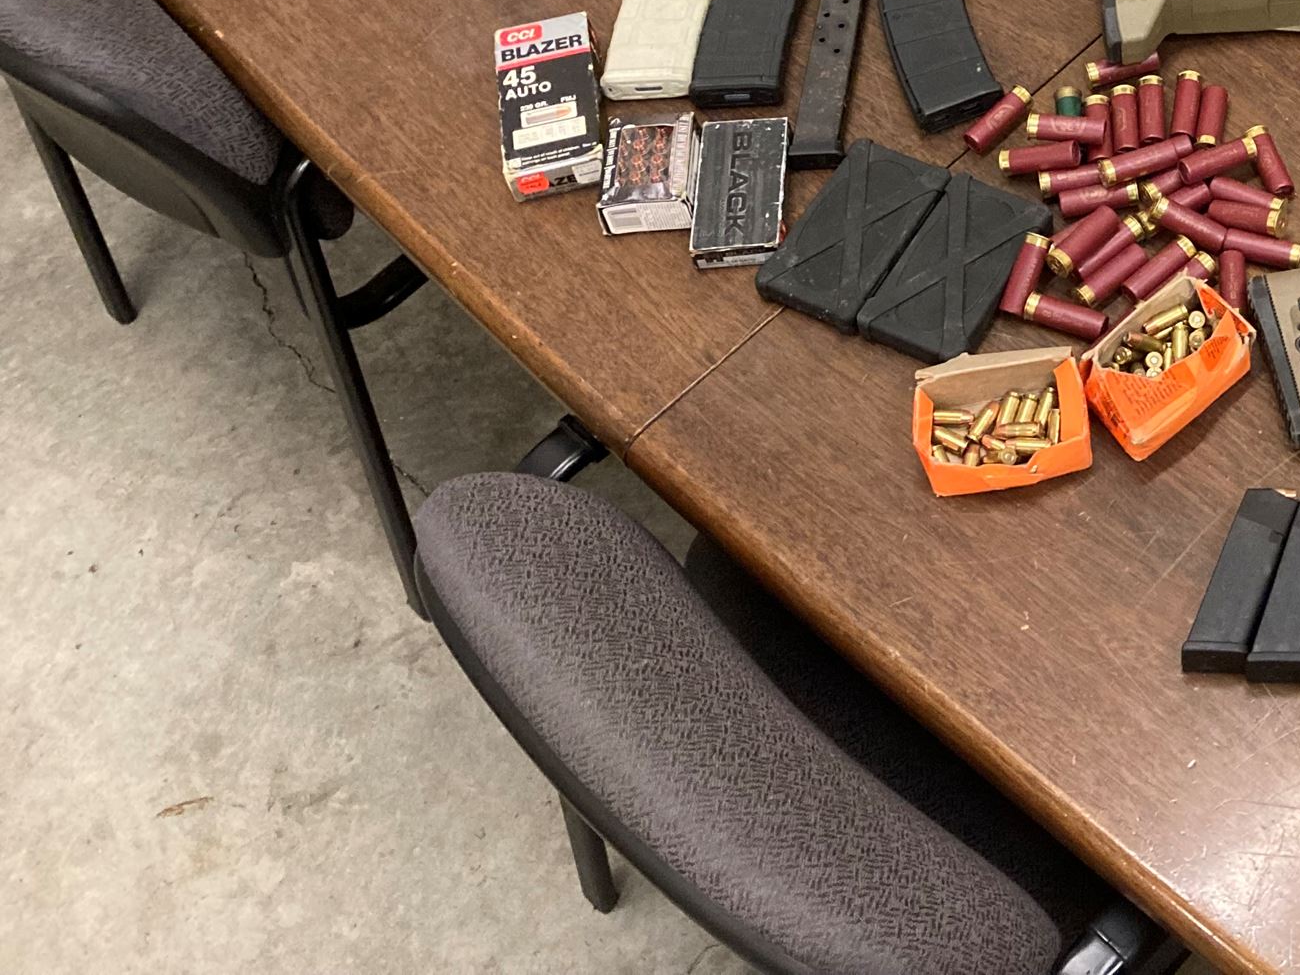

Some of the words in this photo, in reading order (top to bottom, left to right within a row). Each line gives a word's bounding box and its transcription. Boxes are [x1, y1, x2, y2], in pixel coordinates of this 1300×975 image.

[506, 28, 536, 43] CCI
[501, 34, 583, 63] BLAZER
[502, 66, 537, 88] 45
[505, 81, 552, 101] AUTO
[724, 131, 753, 235] BLACK
